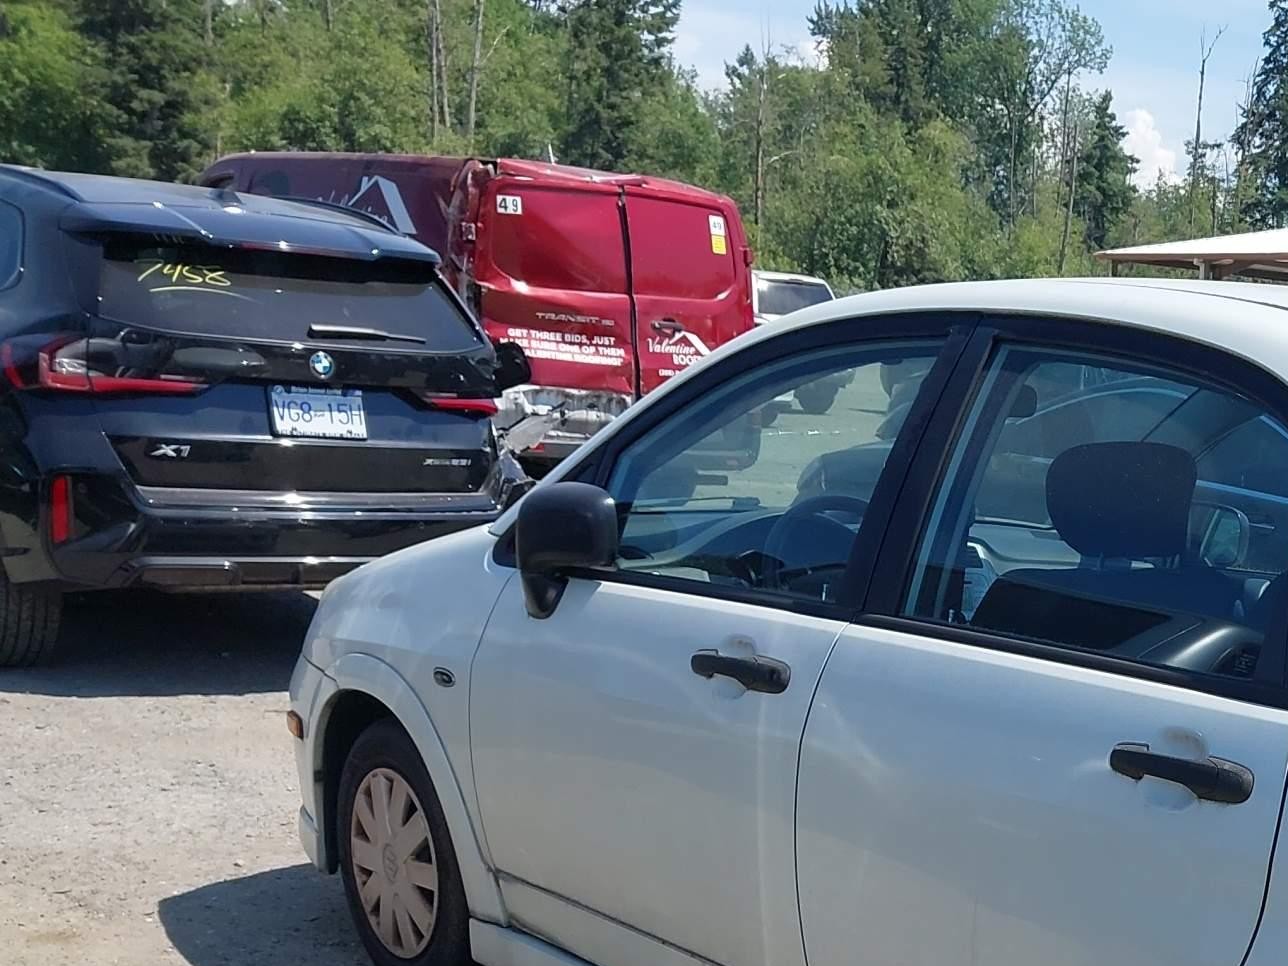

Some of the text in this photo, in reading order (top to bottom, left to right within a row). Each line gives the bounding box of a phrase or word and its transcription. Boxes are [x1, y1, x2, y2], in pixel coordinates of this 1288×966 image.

[499, 198, 519, 213] 49
[536, 312, 599, 324] TRANSIT
[507, 328, 616, 346] GET THREE BIDS, JUST
[647, 336, 696, 353] Valentine
[525, 348, 573, 360] ALENTINE
[531, 340, 557, 351] SURE
[559, 342, 580, 353] ONE
[582, 345, 596, 354] OF
[598, 346, 625, 358] THEM
[275, 399, 364, 427] VG8 15H
[150, 444, 191, 457] X1
